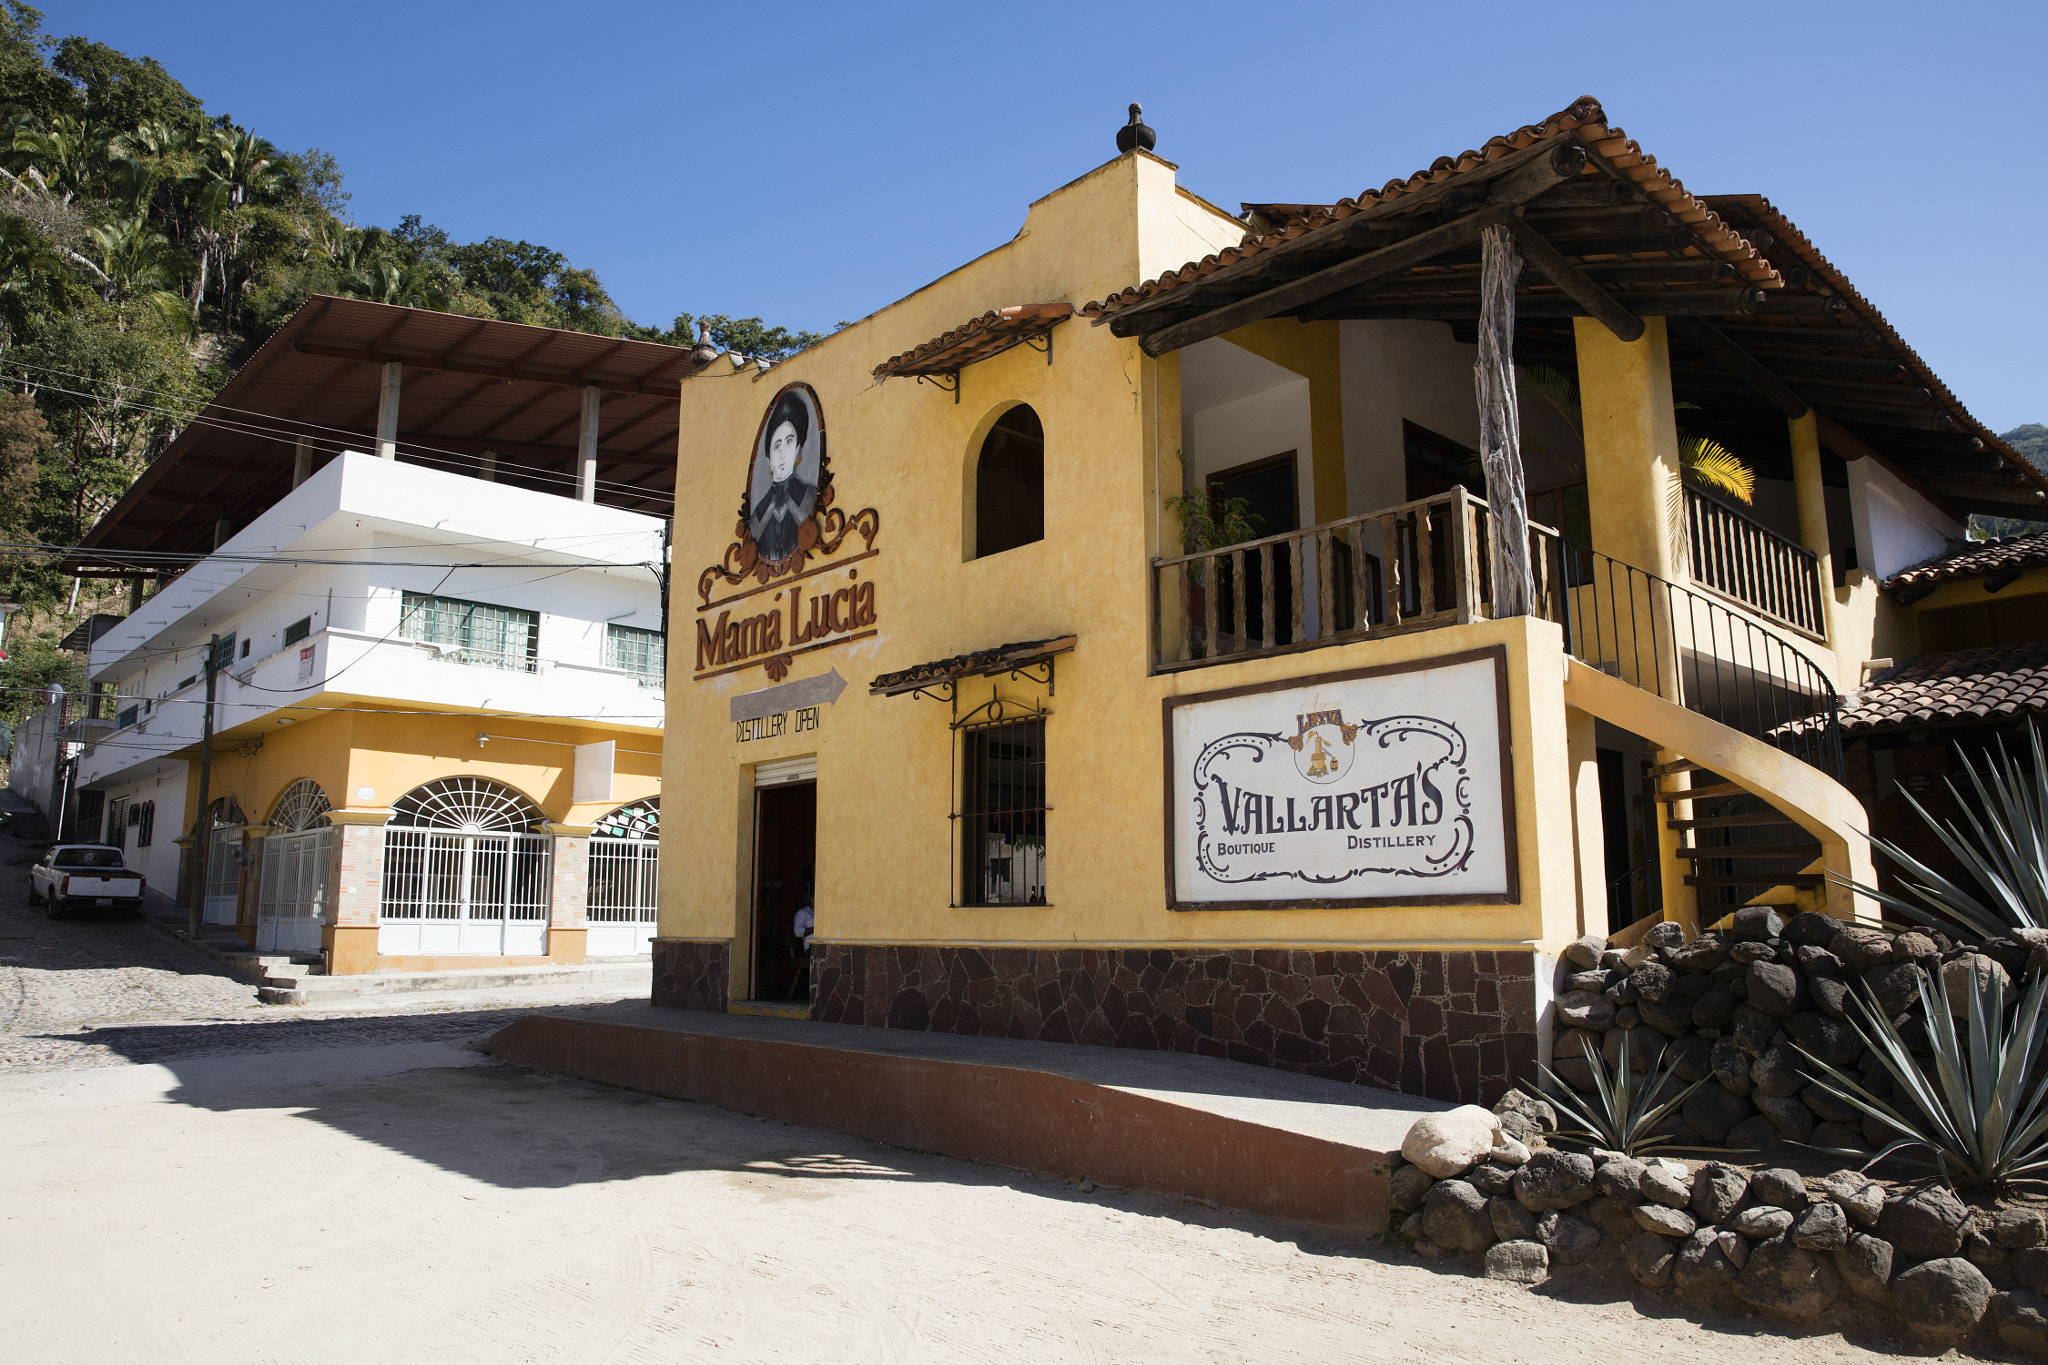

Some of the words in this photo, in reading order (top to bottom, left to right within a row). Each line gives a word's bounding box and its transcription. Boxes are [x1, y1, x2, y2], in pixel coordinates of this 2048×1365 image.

[695, 592, 783, 671] Mamá
[736, 711, 788, 743] DISTILLERY
[795, 706, 819, 733] OPEN
[1296, 709, 1346, 737] LEYVA
[1211, 757, 1448, 836] VALLARTA'S
[1217, 842, 1276, 856] BOUTIQUE
[1347, 835, 1437, 850] DISTILLERY
